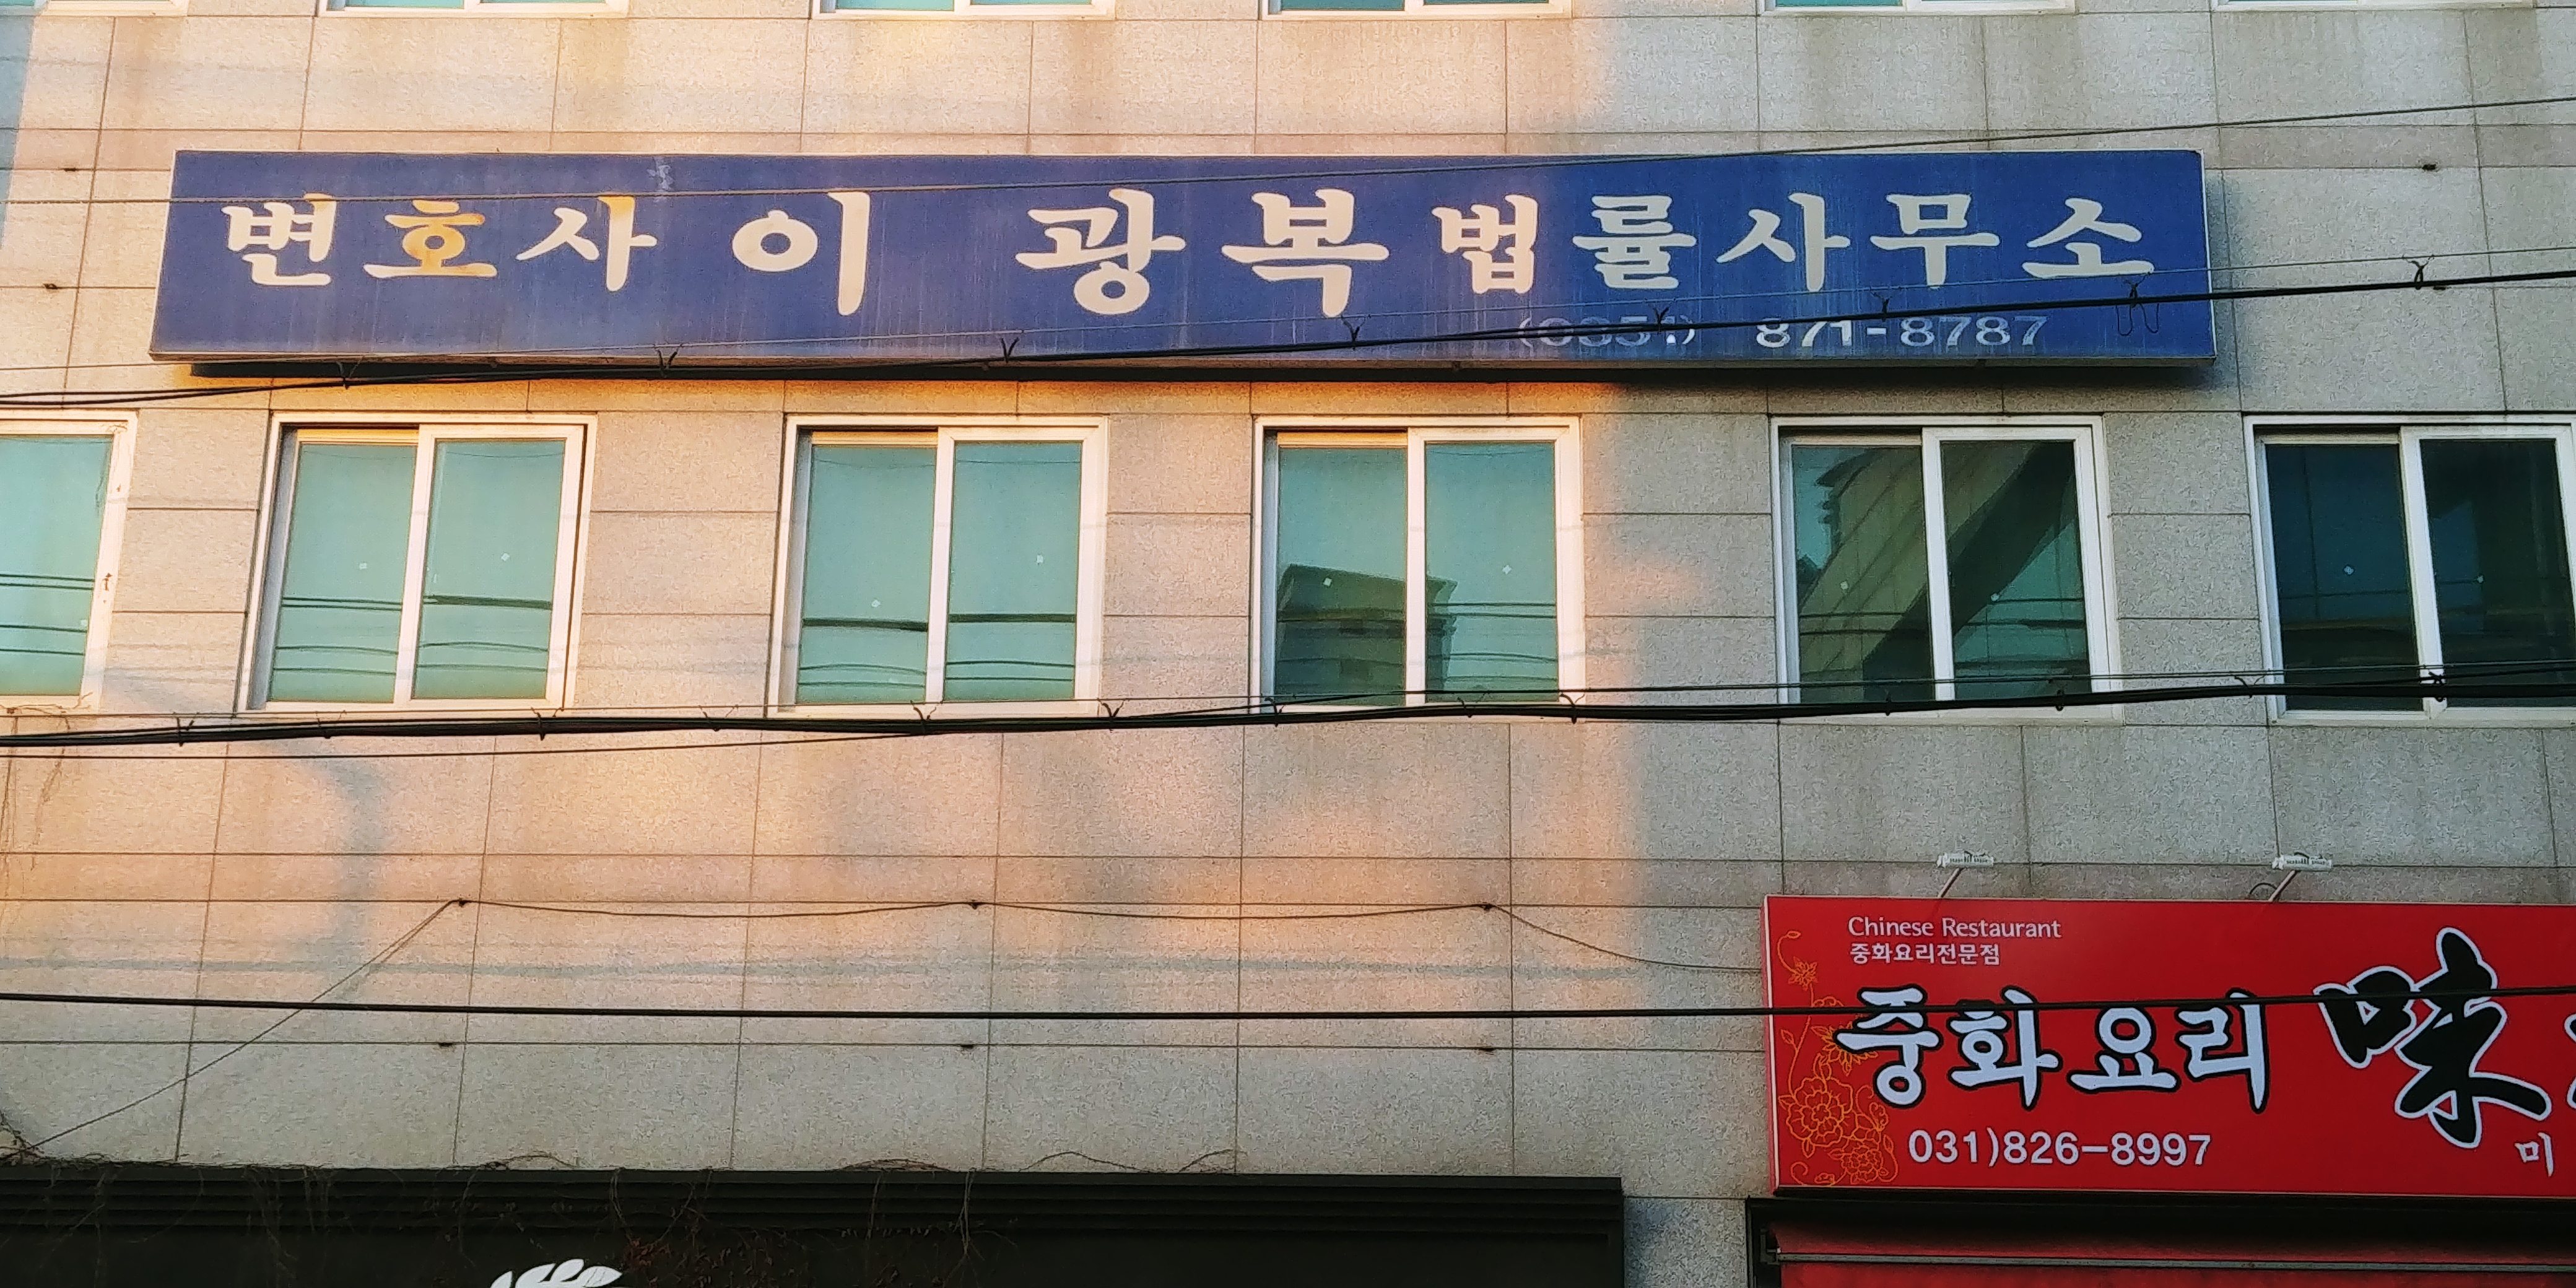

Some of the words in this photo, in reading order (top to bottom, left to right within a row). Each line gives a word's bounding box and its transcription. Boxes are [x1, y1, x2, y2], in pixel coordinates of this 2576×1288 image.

[222, 192, 658, 292] 변호사
[732, 190, 871, 316] 이
[1015, 188, 1390, 318] 광복
[1432, 193, 2155, 295] 법률사무소
[1755, 316, 2048, 349] 871-8787
[1847, 916, 1934, 937] Chinese
[1941, 918, 2063, 938] Restaurant
[1850, 942, 2000, 966] 중화요리전문점
[1833, 985, 2270, 1113] 중화요리
[2312, 926, 2576, 1149] 味
[1908, 1127, 2211, 1167] 031)826-8997
[2514, 1132, 2555, 1177] 미
